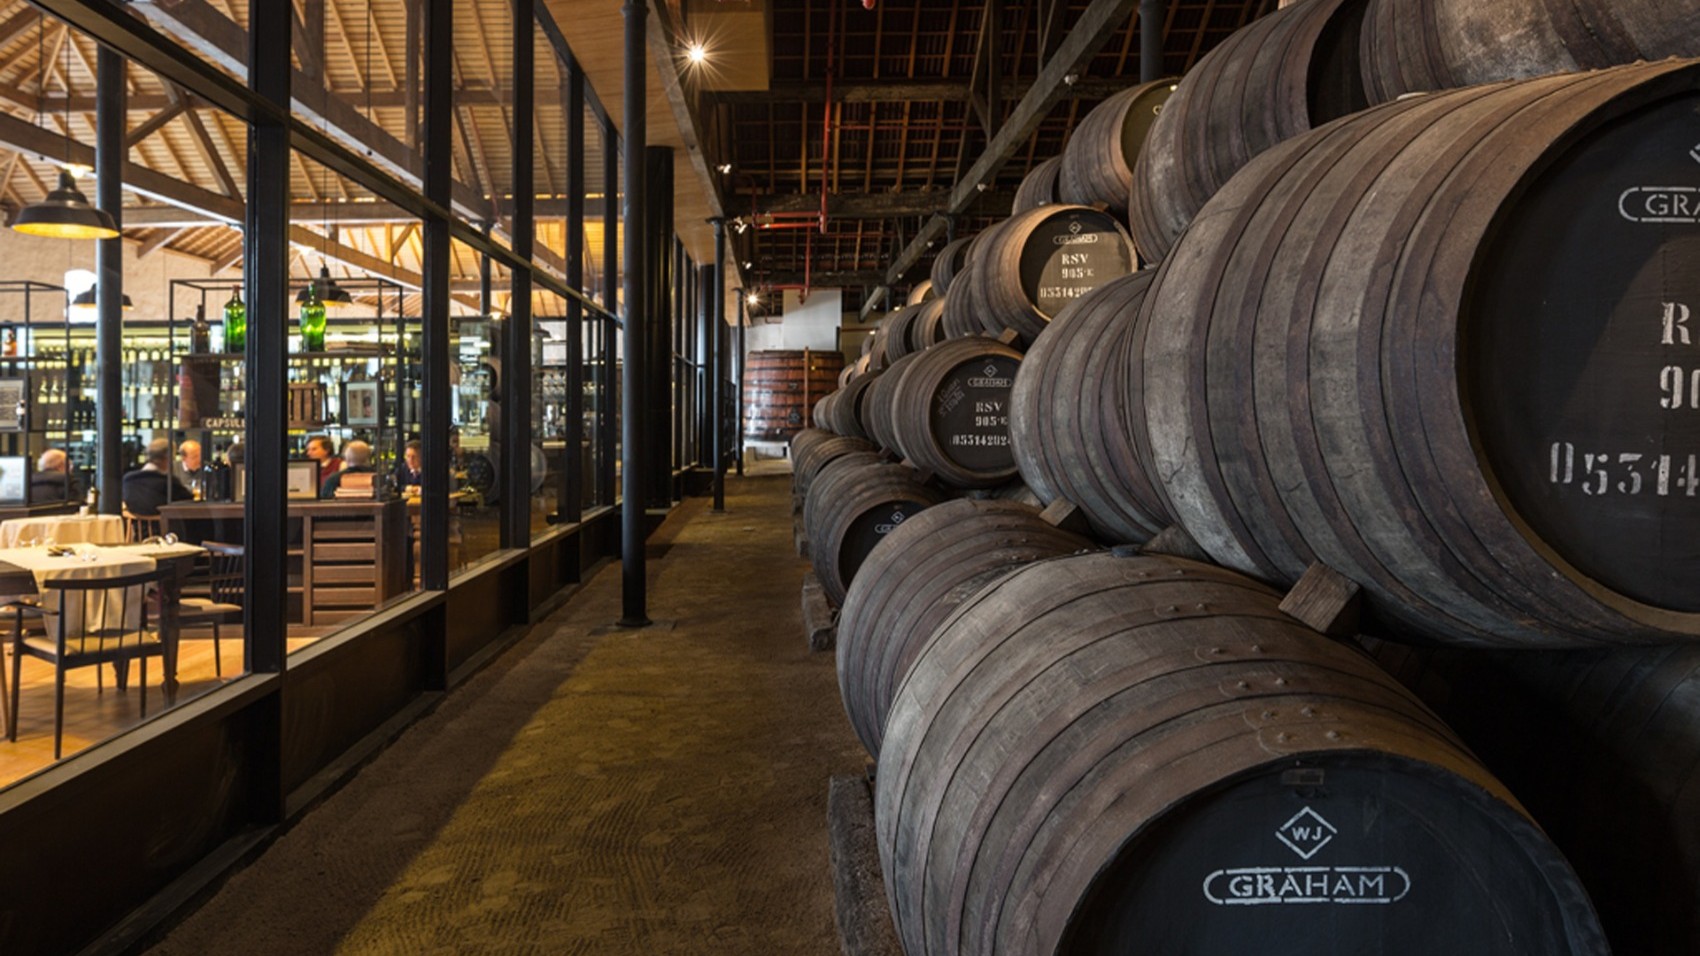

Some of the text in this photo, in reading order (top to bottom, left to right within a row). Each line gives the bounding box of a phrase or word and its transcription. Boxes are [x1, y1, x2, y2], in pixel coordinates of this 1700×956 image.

[1061, 253, 1089, 265] RSV
[1661, 302, 1700, 345] R
[975, 401, 1002, 413] RSV
[1550, 442, 1700, 496] 05314
[1291, 826, 1323, 841] WJ
[1228, 873, 1384, 898] GRAHAM
